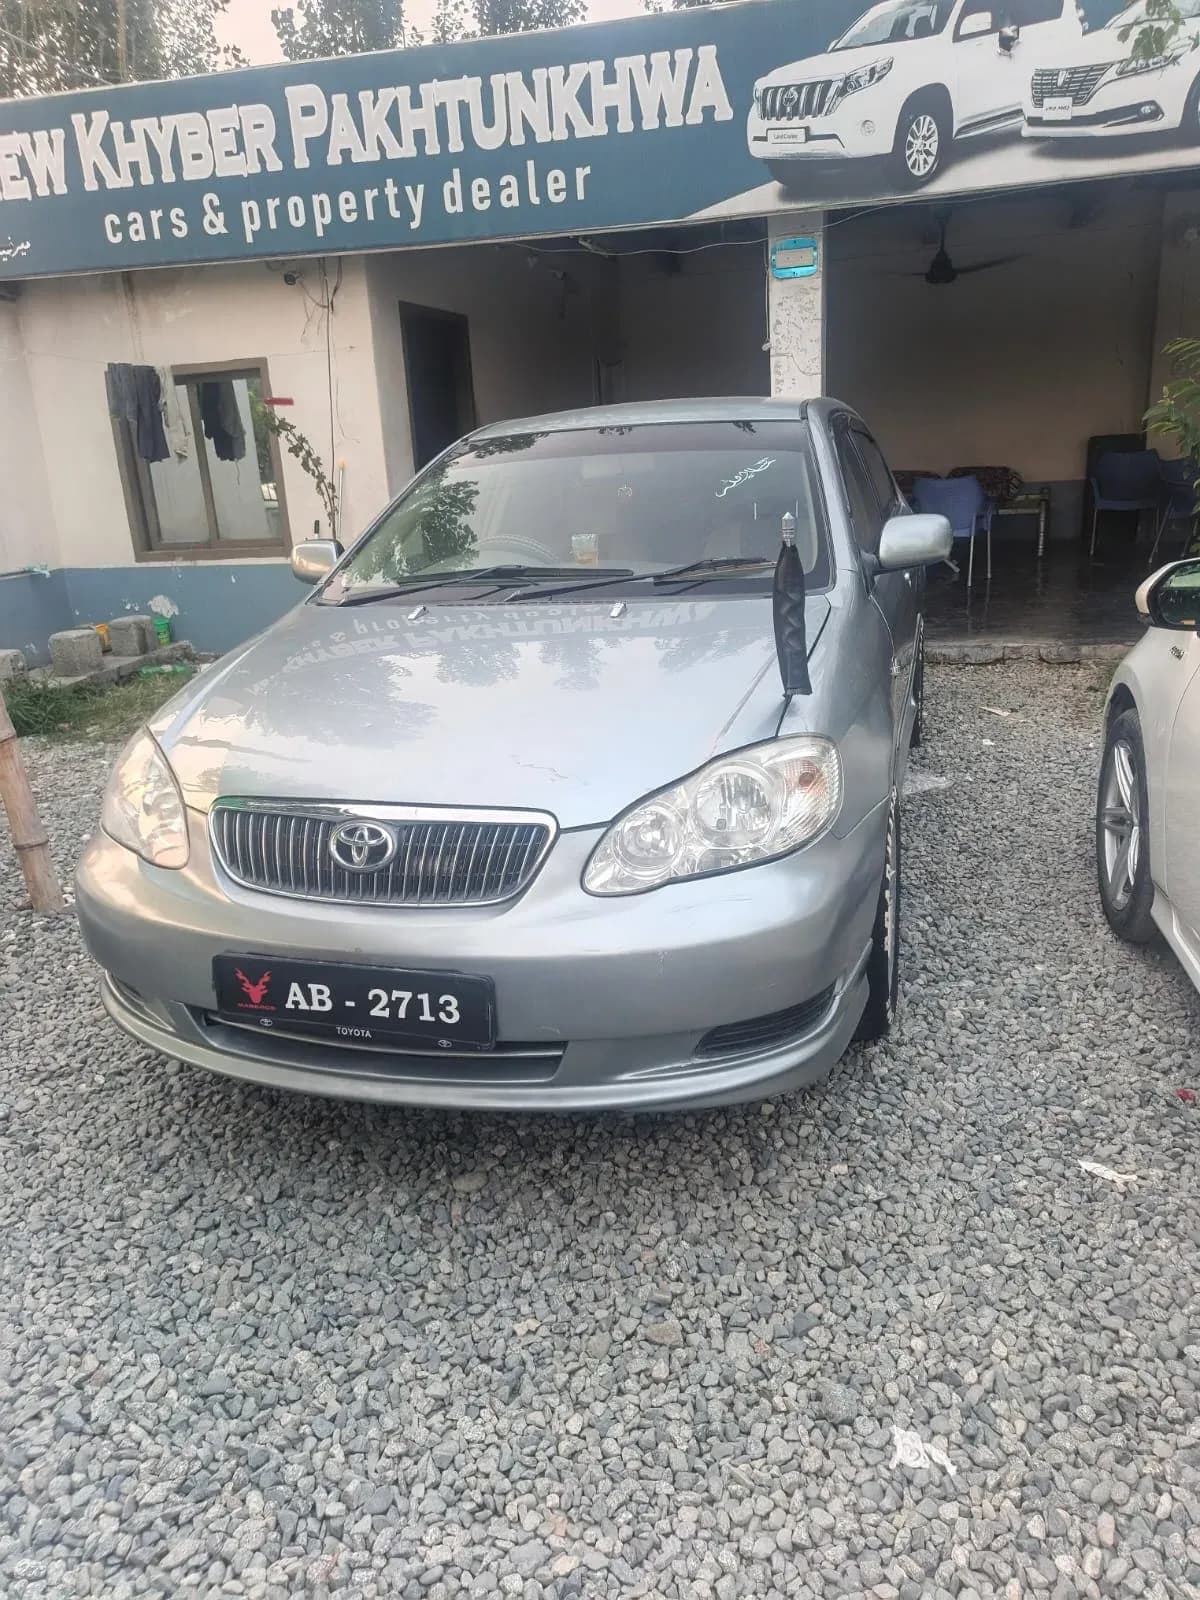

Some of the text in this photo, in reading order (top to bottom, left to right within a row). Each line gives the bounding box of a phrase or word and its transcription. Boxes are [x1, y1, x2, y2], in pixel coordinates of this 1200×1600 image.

[0, 128, 68, 201] EW
[285, 45, 734, 169] PAKHTUNKHWA
[104, 160, 591, 244] cars & property dealer
[285, 982, 461, 1024] AB - 2713
[336, 1026, 372, 1039] TOYOTA
